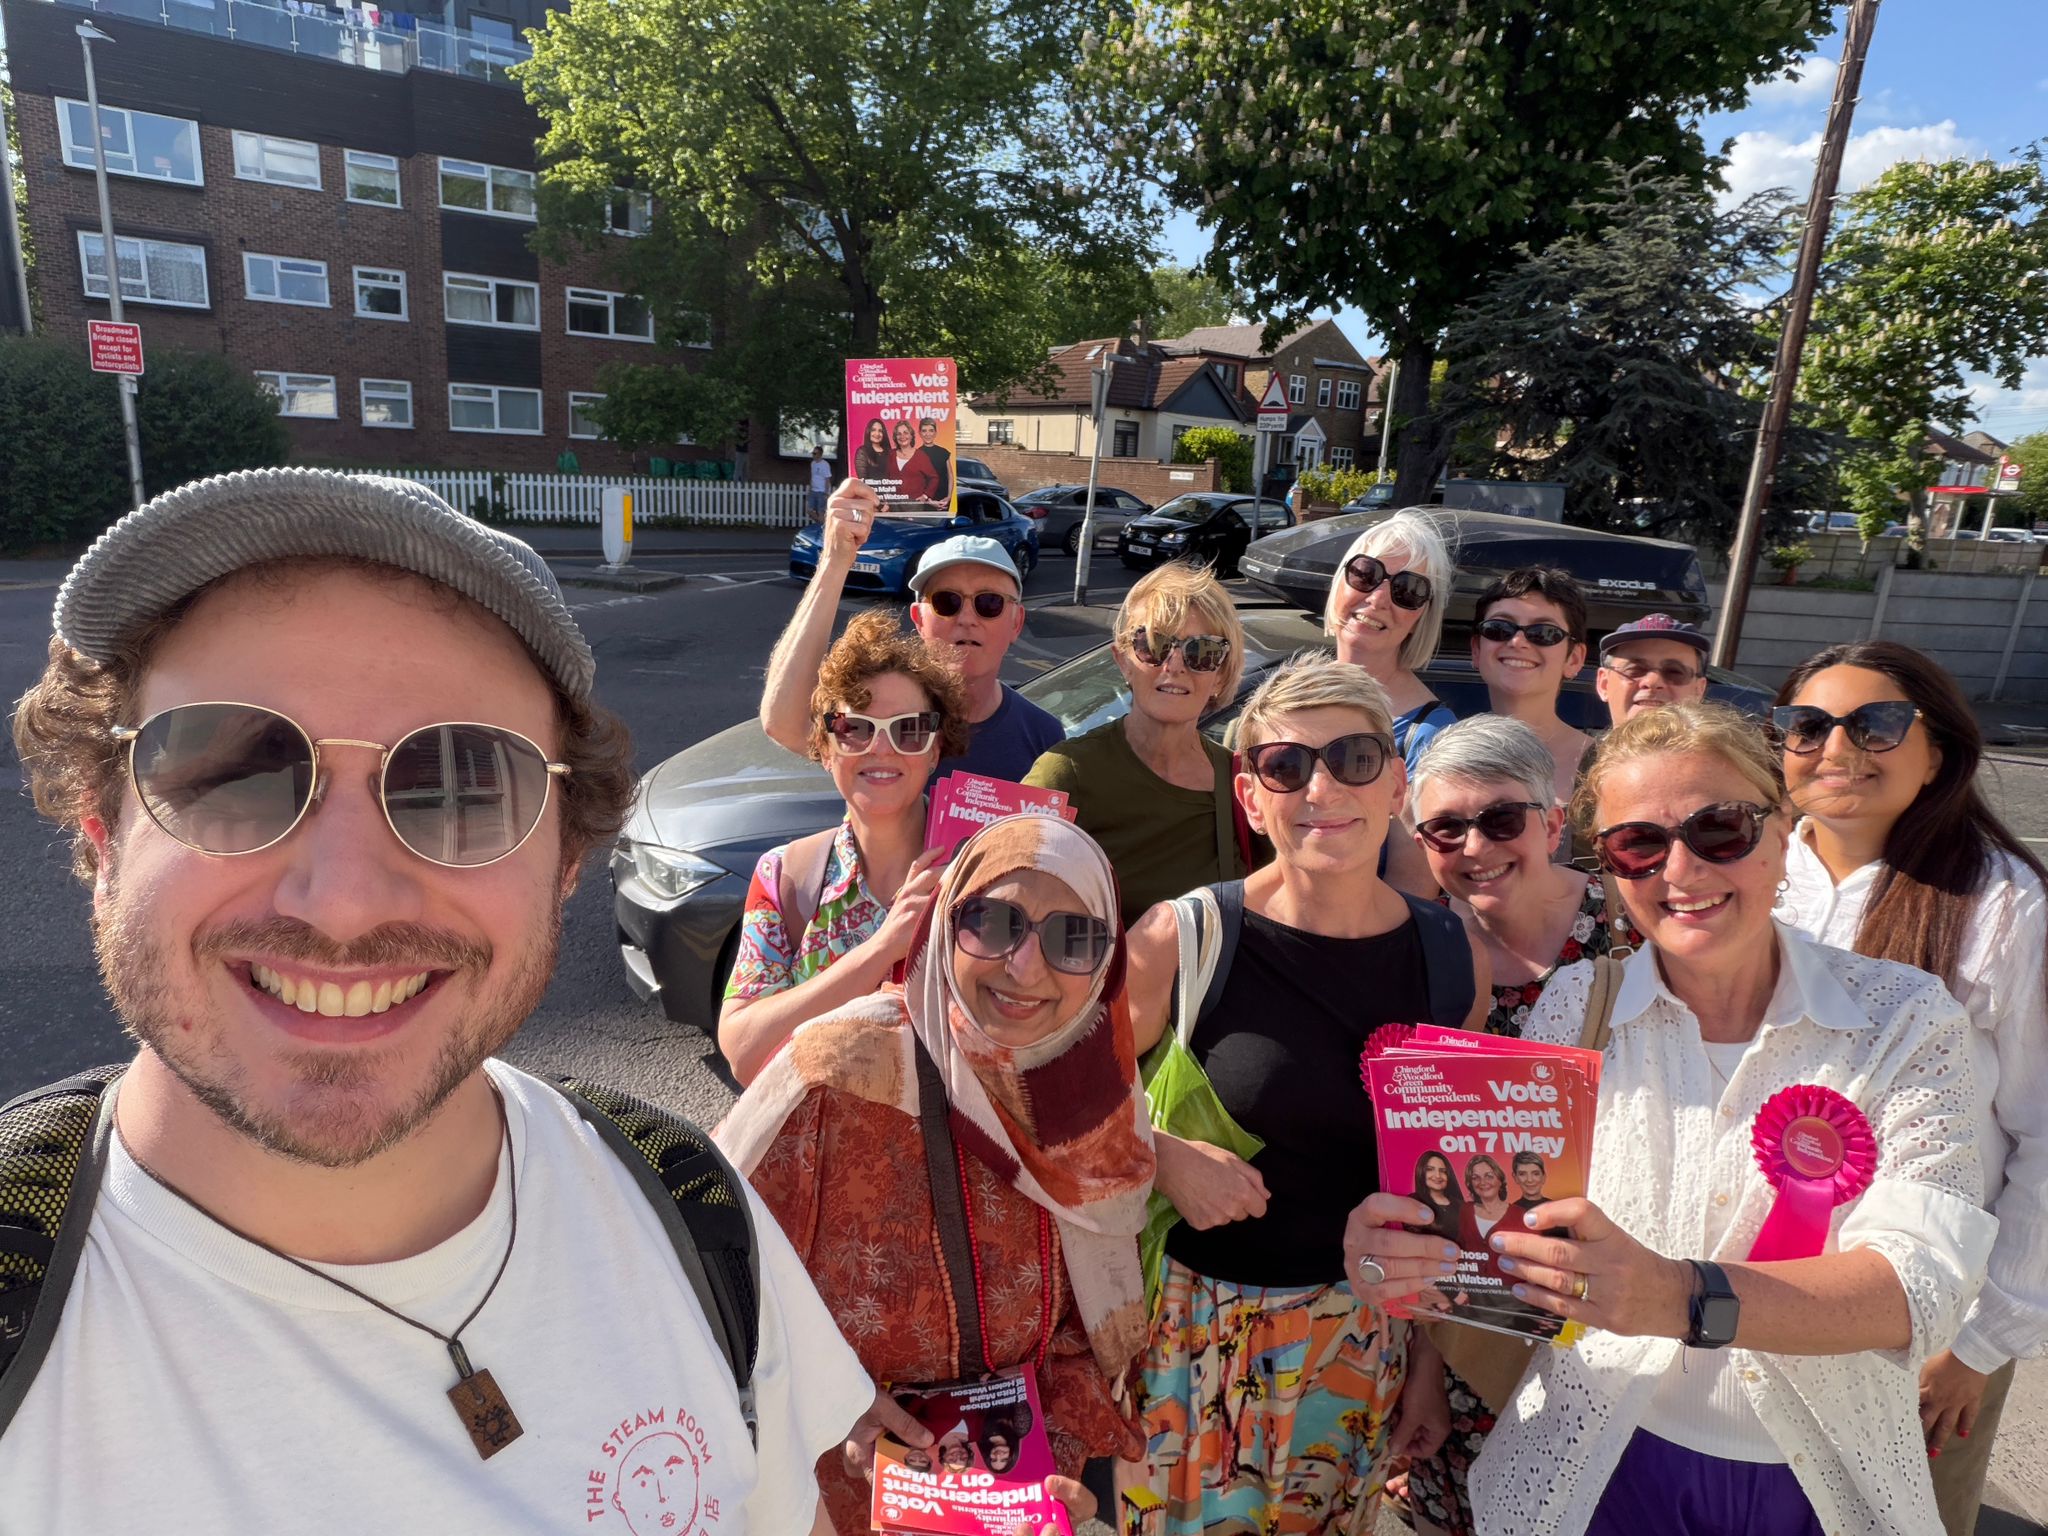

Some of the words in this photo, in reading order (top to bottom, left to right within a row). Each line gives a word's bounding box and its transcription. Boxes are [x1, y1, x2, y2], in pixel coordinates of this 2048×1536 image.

[93, 332, 114, 342] Bridge
[116, 336, 138, 344] closed
[99, 344, 120, 352] except
[97, 352, 122, 360] cyclists
[95, 361, 139, 370] motorcyclists
[911, 374, 948, 387] Vote
[851, 390, 950, 406] Independent
[880, 408, 900, 420] on
[902, 406, 913, 419] 7
[915, 406, 950, 422] May
[956, 787, 1000, 802] Community
[965, 796, 1012, 812] Independents
[1020, 800, 1059, 817] Vote
[1394, 1064, 1435, 1074] Chingford
[1384, 1082, 1453, 1095] Community
[1488, 1080, 1558, 1103] Vote
[1403, 1092, 1480, 1105] Independents
[1384, 1106, 1563, 1131] Independent
[1439, 1135, 1476, 1152] on
[1478, 1133, 1498, 1152] 7
[1504, 1132, 1565, 1158] May
[1460, 1250, 1489, 1260] hose
[1457, 1274, 1503, 1286] Watson
[587, 1470, 607, 1522] THE
[601, 1406, 665, 1458] STEAM
[676, 1407, 712, 1464] ROOM
[882, 1463, 937, 1486] May
[941, 1474, 958, 1488] 7
[961, 1474, 995, 1488] on
[882, 1477, 1043, 1507] Independent
[882, 1492, 944, 1516] Vote
